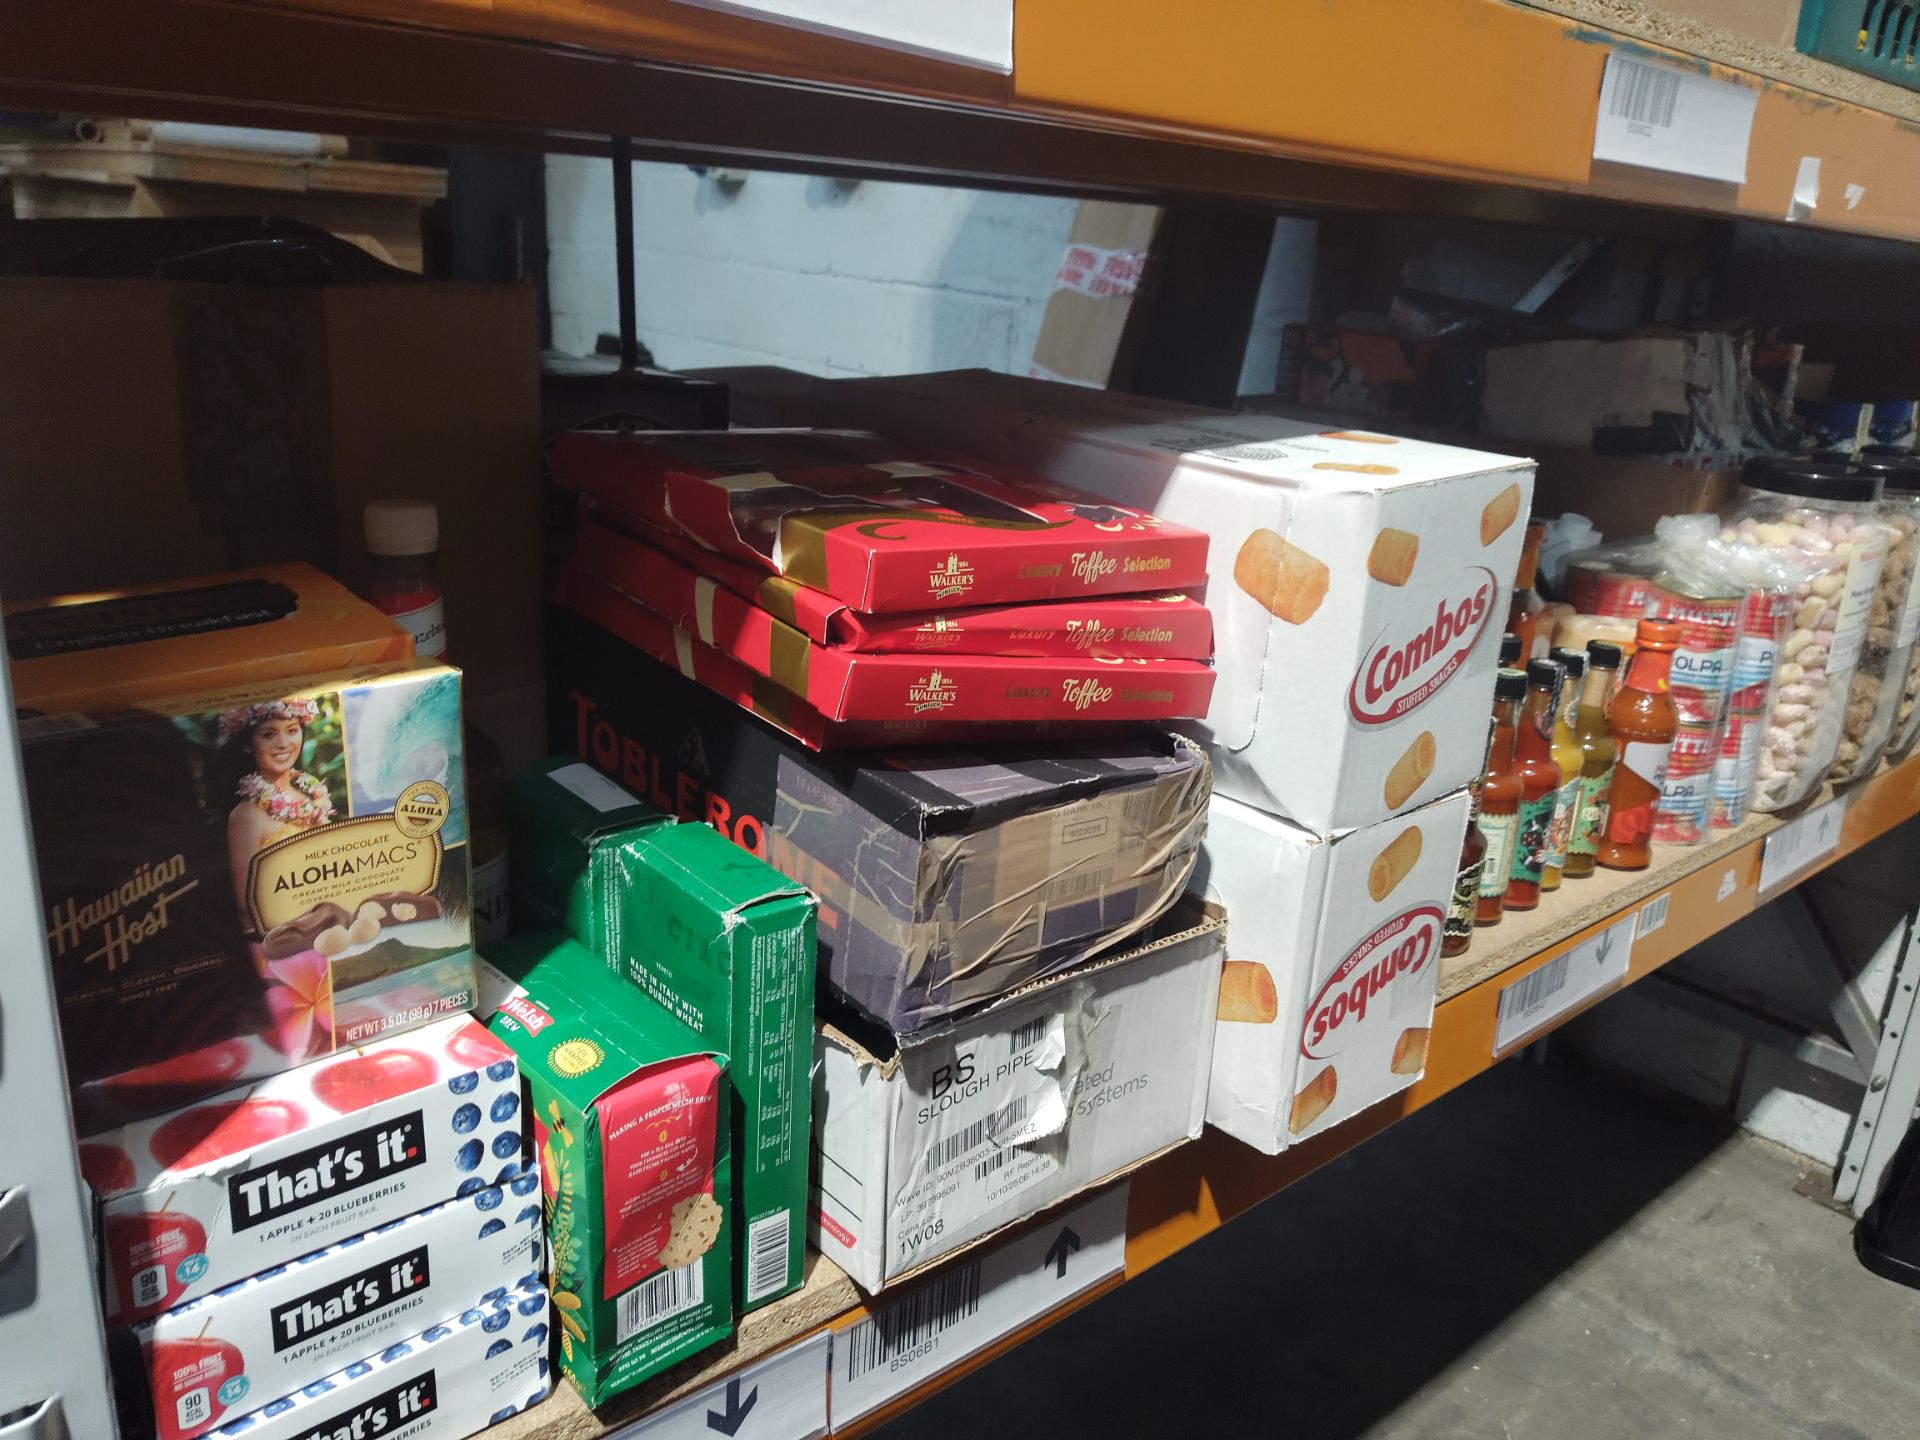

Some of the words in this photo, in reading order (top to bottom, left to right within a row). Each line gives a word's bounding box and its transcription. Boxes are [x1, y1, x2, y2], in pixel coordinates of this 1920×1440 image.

[930, 574, 974, 587] WALKER'S
[1019, 562, 1063, 580] Luxury
[1071, 551, 1117, 584] Toffee
[1123, 556, 1171, 572] Selection
[936, 585, 962, 599] NONSUCH
[1667, 605, 1737, 627] MUTTI
[915, 632, 961, 642] WALKER'S
[1009, 627, 1055, 641] Luxury
[1066, 619, 1115, 649] Toffee
[1120, 627, 1173, 642] Selection
[1365, 583, 1488, 704] Combos
[909, 688, 956, 701] WALKER'S
[941, 677, 953, 685] 1894
[1006, 682, 1050, 699] Luxury
[1063, 678, 1113, 710] Toffee
[1120, 689, 1173, 703] Selection
[1397, 686, 1427, 713] STUFFED
[1429, 658, 1457, 691] SNACKS
[1663, 784, 1695, 798] LPA
[400, 804, 443, 816] ALOHA
[570, 689, 838, 930] TOBLERONE
[1062, 803, 1088, 817] DARK
[305, 848, 328, 861] MILK
[331, 834, 390, 854] CHOCOLATE
[293, 886, 328, 899] CREAMY
[331, 879, 352, 891] MILK
[355, 866, 405, 884] CHOCOLATE
[300, 891, 342, 906] COVERED
[346, 876, 400, 893] MACADAMIAS
[48, 853, 187, 956] Hawaiian
[84, 879, 199, 971] Host
[1374, 917, 1405, 944] STUFFED
[1343, 937, 1372, 974] SNACKS
[630, 956, 648, 978] MADE
[649, 971, 657, 984] IN
[659, 978, 679, 1004] ITALY
[682, 996, 704, 1020] WITH
[1308, 923, 1432, 1047] Combos
[506, 999, 544, 1030] Welsh
[630, 967, 647, 988] 100%
[649, 982, 673, 1012] DURUM
[676, 1006, 704, 1034] WHEAT
[346, 1026, 363, 1041] NET
[365, 1020, 379, 1035] WT
[381, 1018, 394, 1031] 3.5
[396, 1013, 408, 1026] OZ
[409, 1007, 423, 1022] (99
[424, 1003, 432, 1018] g)
[434, 1000, 439, 1013] 7
[440, 991, 468, 1011] PIECES
[499, 1016, 520, 1032] BREW
[918, 1073, 990, 1125] SLOUGH
[996, 1049, 1035, 1082] PIPE
[932, 1053, 975, 1101] BS
[1074, 1062, 1114, 1096] ated
[1078, 1074, 1148, 1116] systems
[608, 1118, 637, 1141] MAKING
[638, 1116, 644, 1124] A
[645, 1104, 671, 1120] PROPER
[239, 1146, 364, 1217] That's
[1003, 1168, 1015, 1180] RF
[1017, 1153, 1046, 1173] Reprint
[896, 1190, 921, 1207] Wave
[923, 1181, 935, 1194] ID:
[267, 1218, 304, 1240] APPLE
[307, 1215, 316, 1225] +
[319, 1209, 332, 1221] 20
[333, 1181, 407, 1215] BLUEBERRIES
[901, 1209, 914, 1223] LP:
[156, 1227, 181, 1245] FRUIT
[291, 1233, 301, 1243] IN
[304, 1224, 329, 1240] EACH
[330, 1214, 356, 1229] FRUIT
[898, 1223, 919, 1240] Cons
[901, 1219, 944, 1255] 1W08
[140, 1271, 158, 1287] 90
[280, 1278, 379, 1339] That's
[290, 1340, 326, 1361] APPLE
[328, 1334, 337, 1344] +
[340, 1328, 351, 1339] 20
[355, 1296, 424, 1332] BLUEBERRIES
[314, 1353, 324, 1362] IN
[326, 1343, 350, 1359] EACH
[351, 1332, 376, 1346] FRUIT
[890, 1338, 939, 1373] BS06B1
[173, 1363, 198, 1380] 100%
[199, 1352, 223, 1369] FRUIT
[490, 1368, 508, 1382] BEST
[185, 1393, 201, 1410] 90
[186, 1406, 203, 1418] KCAL
[309, 1406, 388, 1440] hat's
